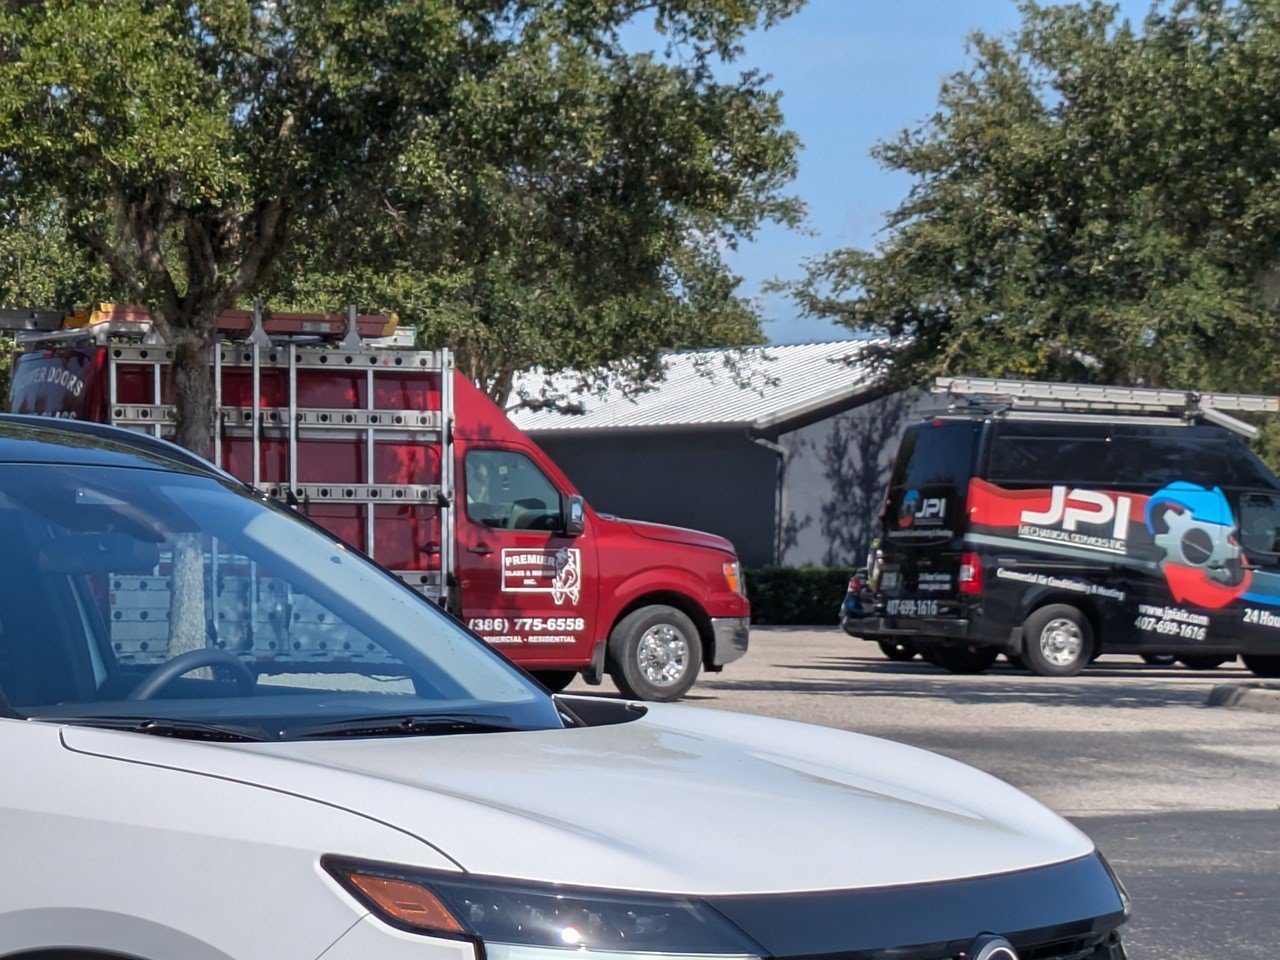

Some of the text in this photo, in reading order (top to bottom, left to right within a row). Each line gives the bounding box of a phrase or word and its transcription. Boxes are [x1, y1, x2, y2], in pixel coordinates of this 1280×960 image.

[47, 366, 83, 397] DOORS
[915, 498, 946, 518] JPI
[1020, 485, 1132, 540] JPI
[504, 554, 556, 567] PREMIER
[468, 617, 585, 633] (386) 775-6558
[1138, 604, 1210, 626] www.jpiair.com
[1242, 607, 1259, 624] 24
[1134, 616, 1207, 640] 407-699-1616
